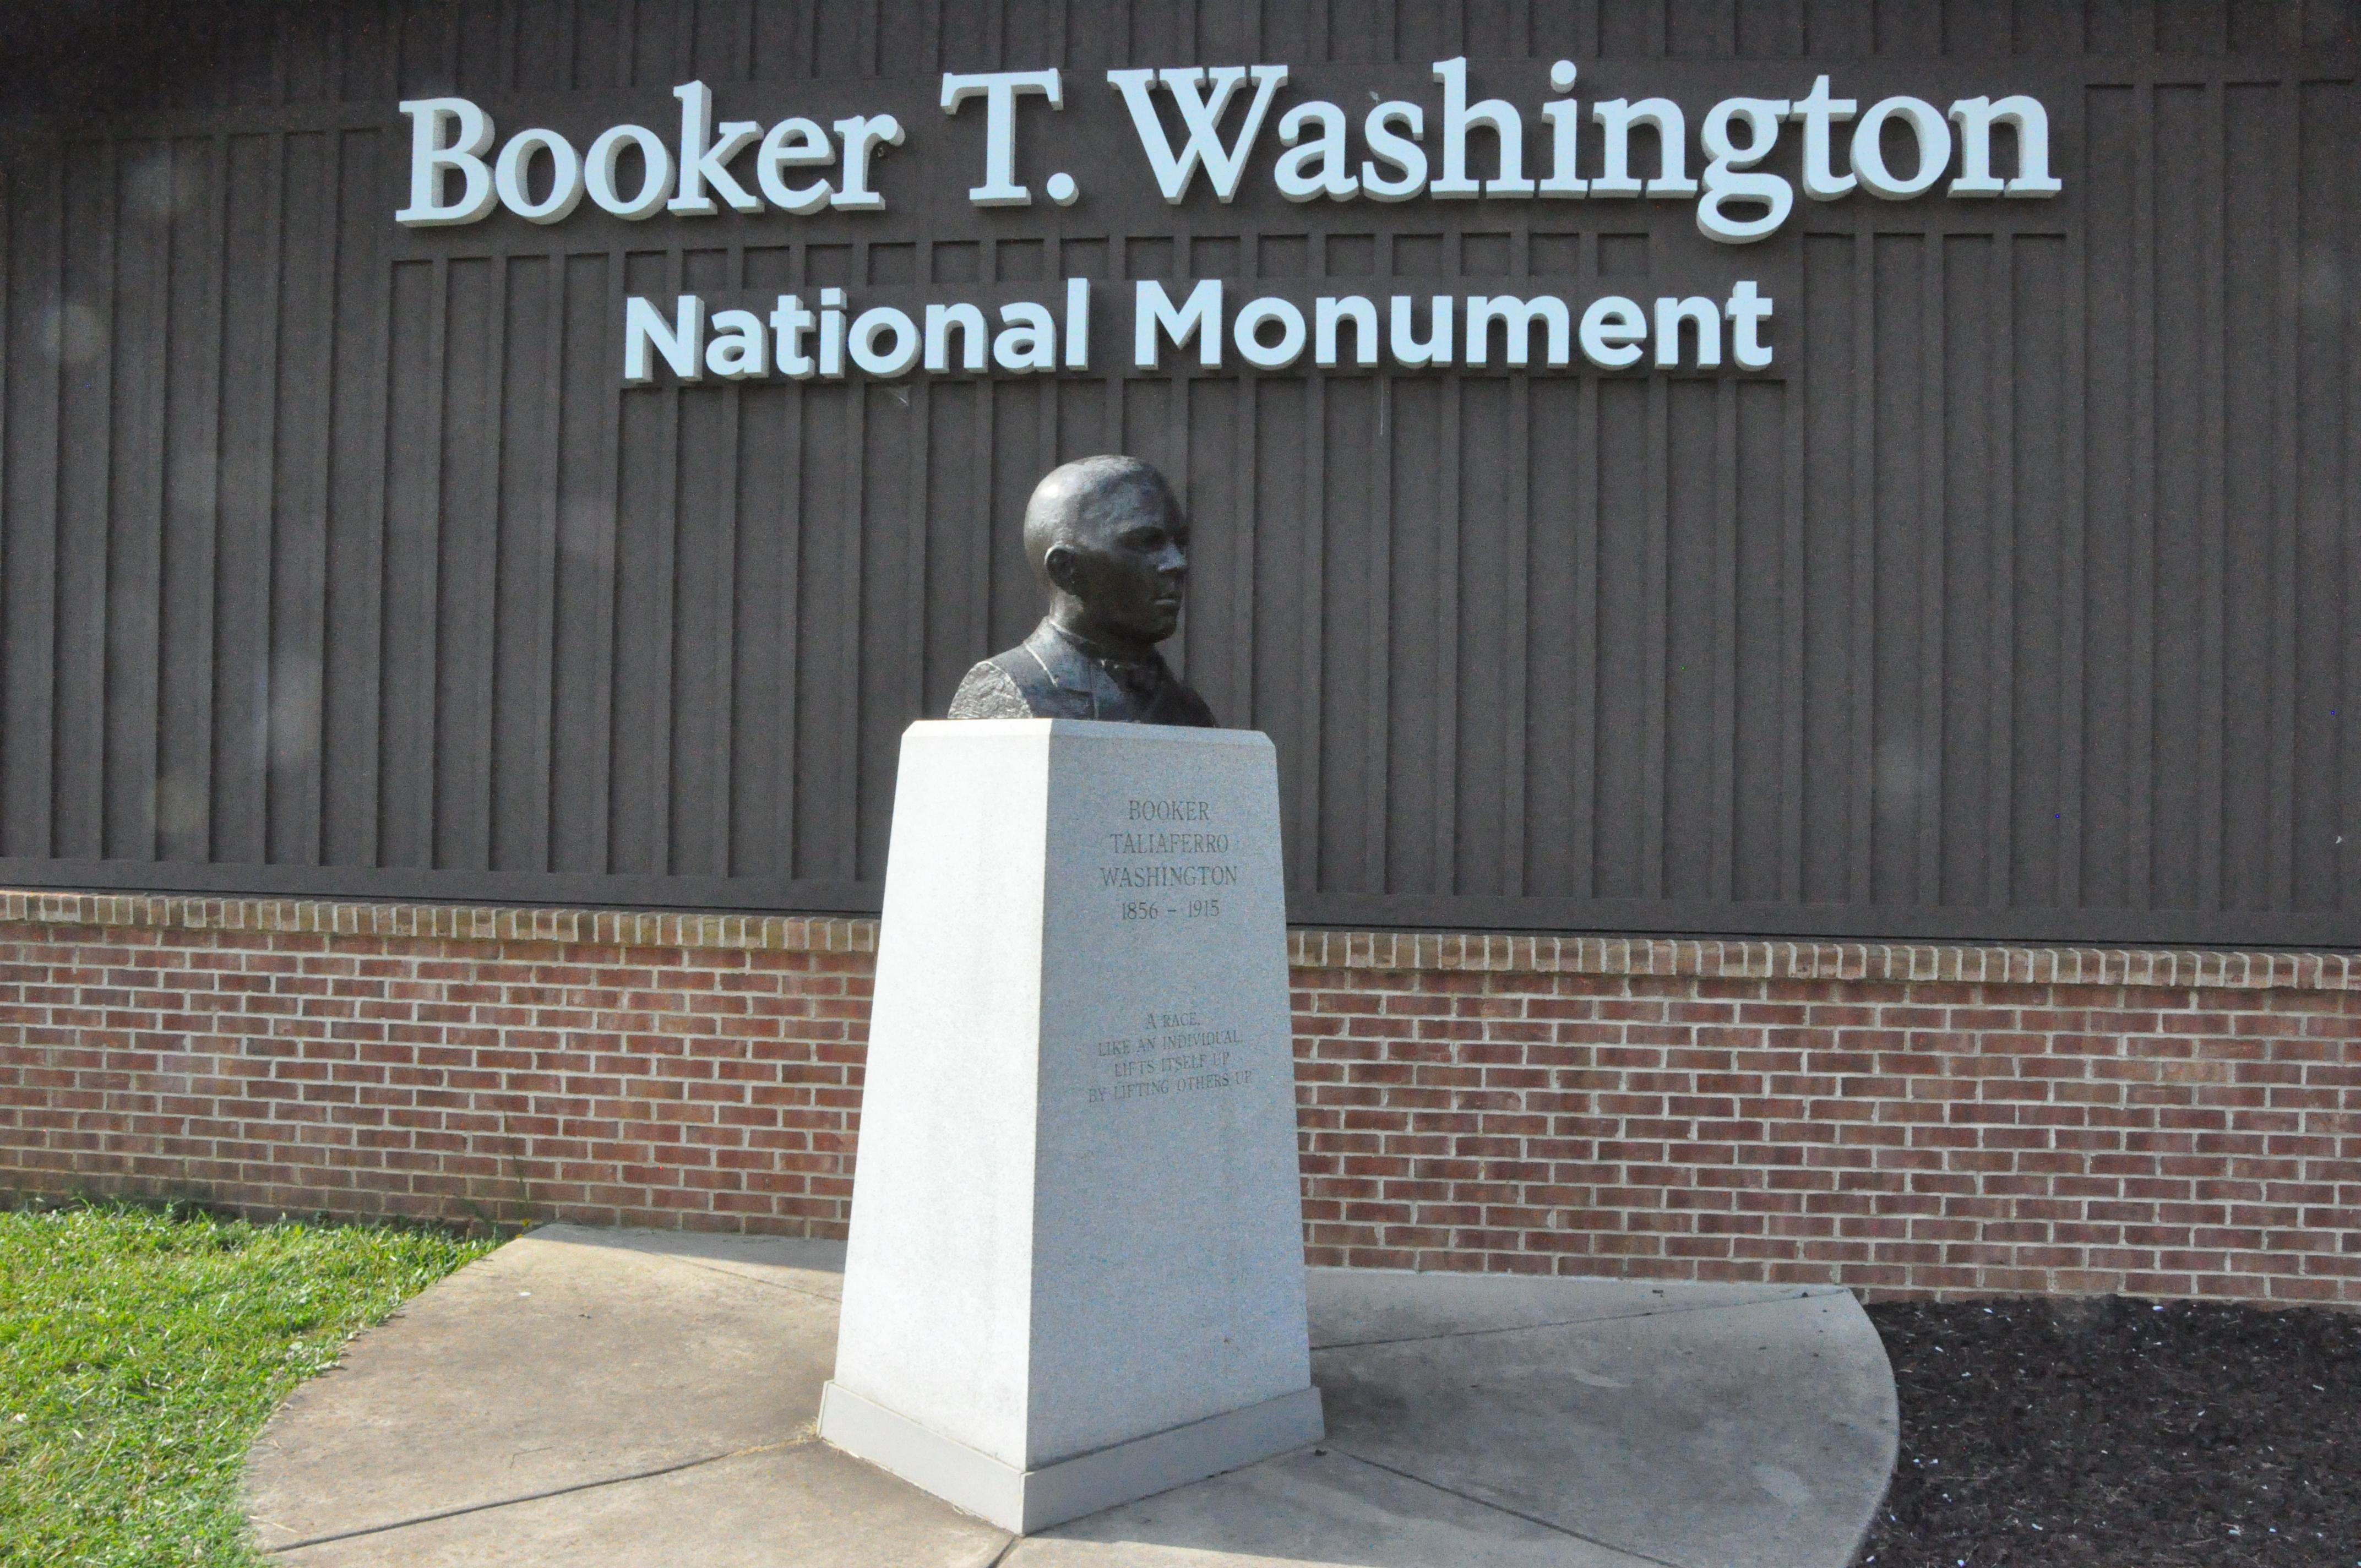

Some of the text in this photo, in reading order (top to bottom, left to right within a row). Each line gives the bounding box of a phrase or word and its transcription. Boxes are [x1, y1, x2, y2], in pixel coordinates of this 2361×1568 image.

[395, 56, 2063, 244] Booker T. Washington
[624, 277, 1774, 382] National Monument
[1129, 800, 1210, 820] BOOKER
[1109, 834, 1229, 853] TALIAFERRO
[1100, 865, 1237, 887] WASHINGTON
[1122, 901, 1158, 920] 1856
[1188, 900, 1220, 918] 1915
[1145, 1013, 1157, 1030] A
[1098, 1040, 1130, 1056] LIKE
[1137, 1037, 1156, 1053] AN
[1114, 1052, 1230, 1077] LIFTS ITSELF UP
[1089, 1087, 1106, 1103] BY
[1114, 1080, 1169, 1100] LIFTING
[1177, 1073, 1230, 1093] OTHERS
